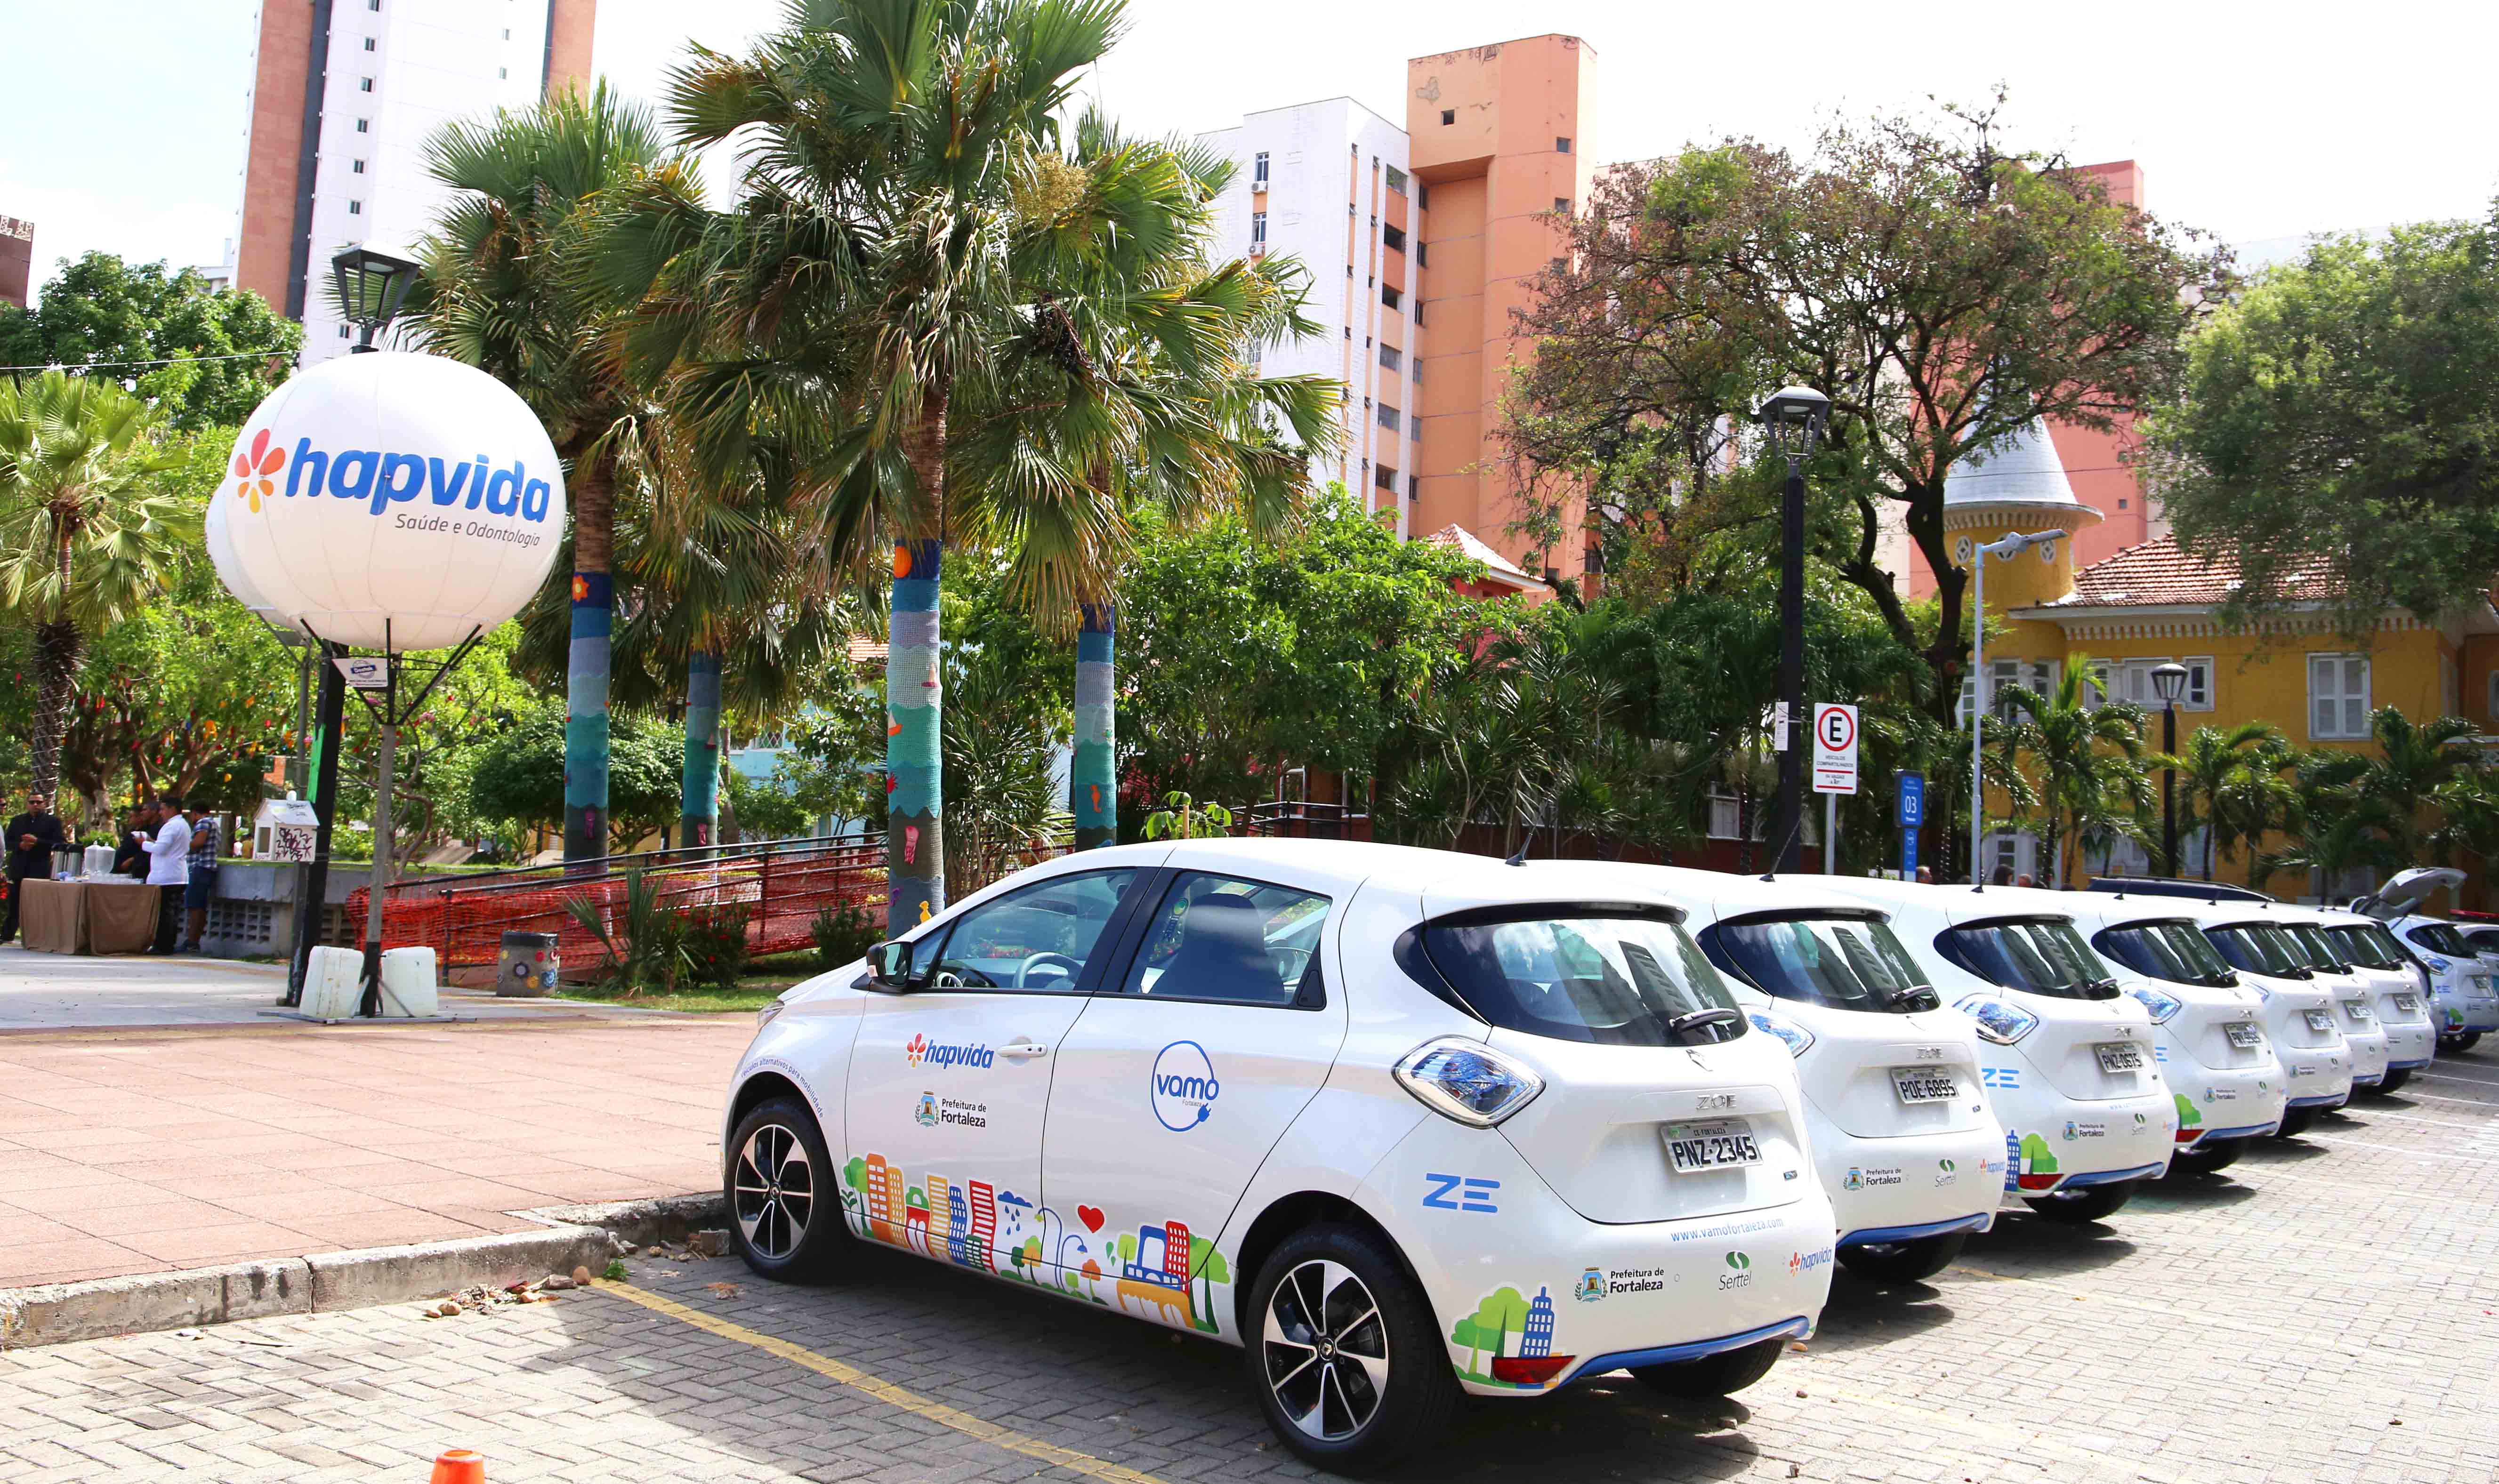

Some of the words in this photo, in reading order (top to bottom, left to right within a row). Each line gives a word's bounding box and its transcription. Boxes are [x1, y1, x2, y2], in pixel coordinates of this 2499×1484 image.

[285, 438, 550, 523] hapvida
[395, 514, 448, 531] Saúde
[453, 523, 462, 533] e
[467, 521, 540, 548] Odontologia
[1830, 716, 1842, 742] E
[1905, 796, 1917, 813] 03
[924, 1039, 994, 1069] hapvida
[1157, 1074, 1219, 1100] vamo
[1981, 1068, 2020, 1088] ZE
[788, 1066, 800, 1079] para
[800, 1076, 824, 1118] mobilidade
[1696, 1093, 1737, 1110] ZOE
[942, 1099, 975, 1111] Prefeitura
[978, 1103, 987, 1112] de
[941, 1110, 985, 1127] Fortaleza
[1671, 1135, 1757, 1167] PNZ-2345
[1423, 1172, 1500, 1213] ZE
[1866, 1176, 1901, 1186] Fortaleza
[1671, 1218, 1785, 1242] www.vamofortaleza.com
[1800, 1246, 1832, 1272] hapvida
[1611, 1269, 1652, 1279] Prefeitura
[1654, 1267, 1664, 1276] de
[1718, 1271, 1752, 1291] Serttel
[1610, 1278, 1663, 1293] Fortaleza
